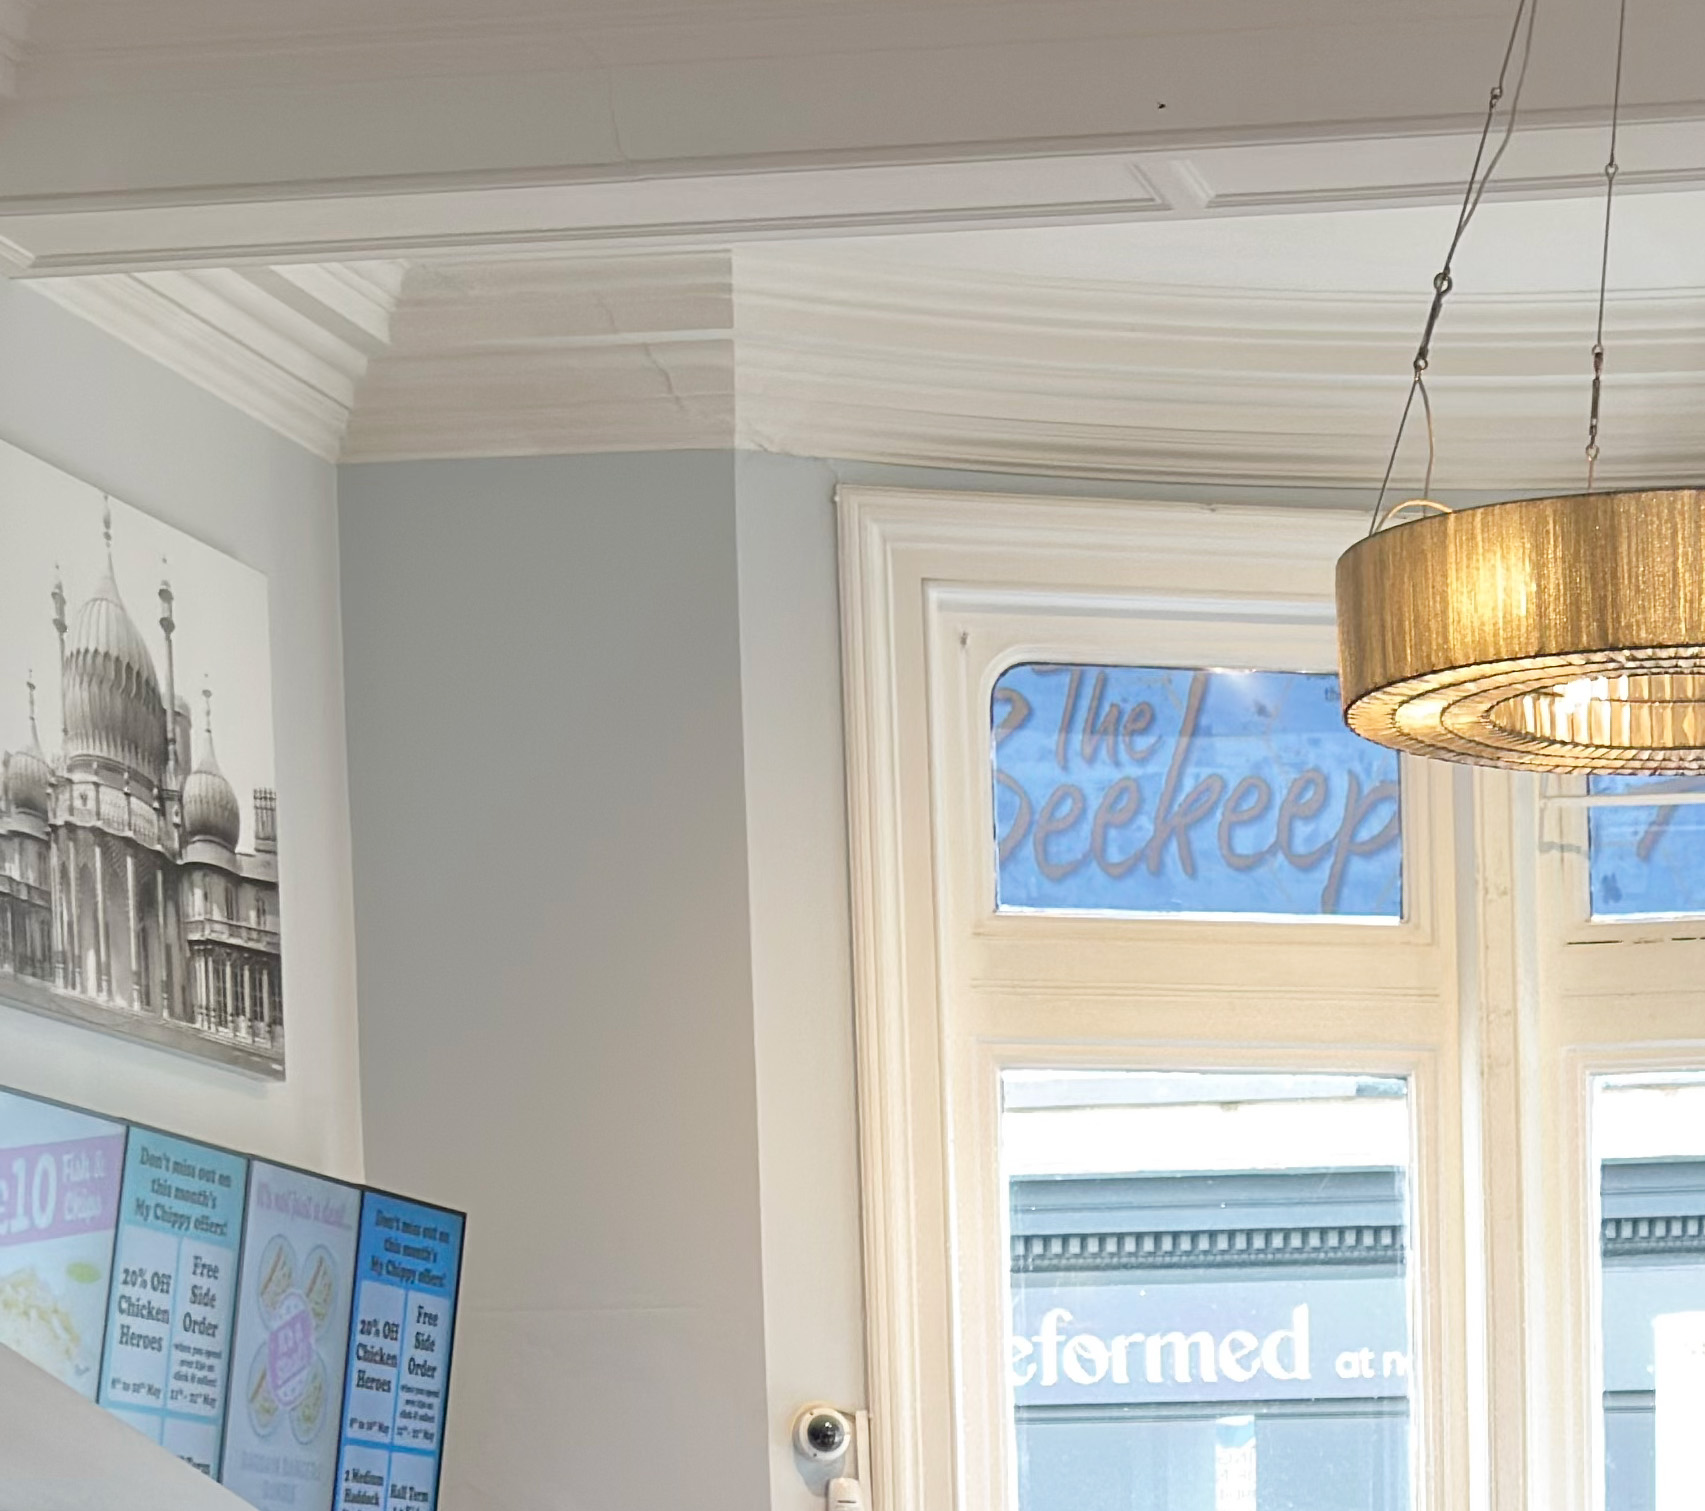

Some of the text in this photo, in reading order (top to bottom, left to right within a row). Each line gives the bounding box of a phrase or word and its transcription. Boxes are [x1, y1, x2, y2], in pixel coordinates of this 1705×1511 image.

[192, 1256, 219, 1280] Free
[121, 1268, 172, 1294] 20% Off
[189, 1284, 217, 1309] Side
[118, 1295, 169, 1325] Chicken
[416, 1305, 439, 1327] Free
[183, 1312, 219, 1338] Order
[119, 1324, 164, 1353] Heroes
[356, 1342, 398, 1368] Chicken
[408, 1357, 437, 1379] Order
[356, 1370, 391, 1393] Heroes
